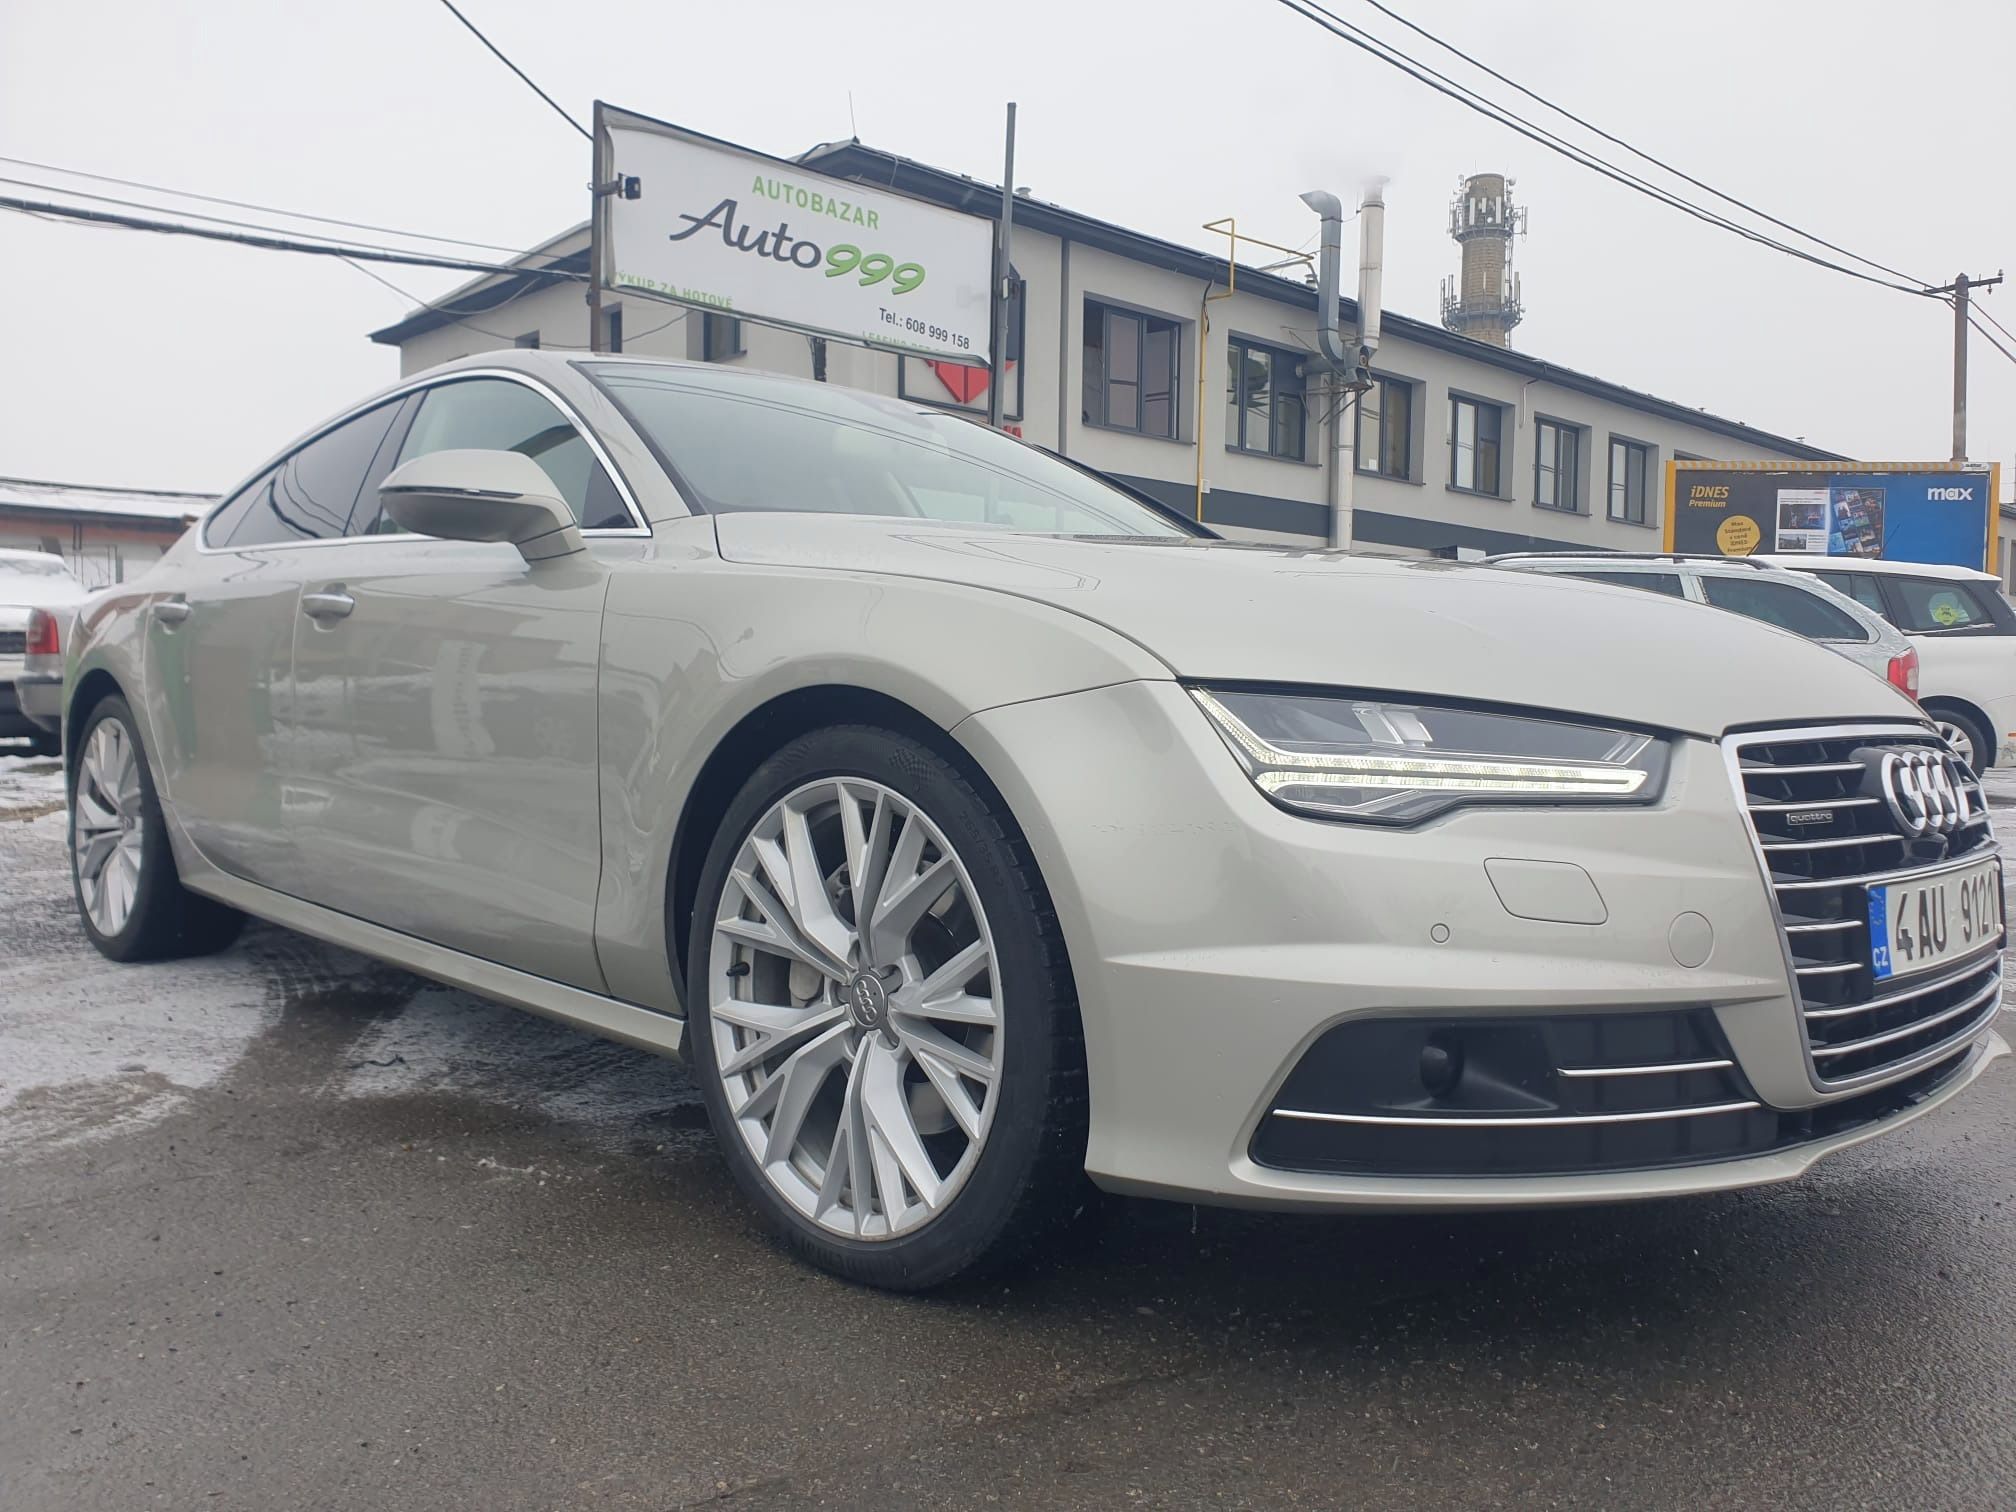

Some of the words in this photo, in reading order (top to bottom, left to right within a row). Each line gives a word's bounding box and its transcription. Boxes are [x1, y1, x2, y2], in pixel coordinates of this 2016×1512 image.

[752, 175, 879, 230] AUTOBAZAR
[879, 307, 903, 328] Tel.:
[905, 317, 926, 335] 608
[928, 325, 948, 342] 999
[951, 333, 970, 350] 158
[1690, 485, 1729, 498] iDNES
[1927, 487, 1973, 501] max
[1689, 499, 1726, 508] Premium
[1790, 813, 1833, 824] quattro
[1896, 884, 1948, 961] 4AU
[1961, 871, 1997, 943] 9121
[1873, 948, 1889, 967] CZ
